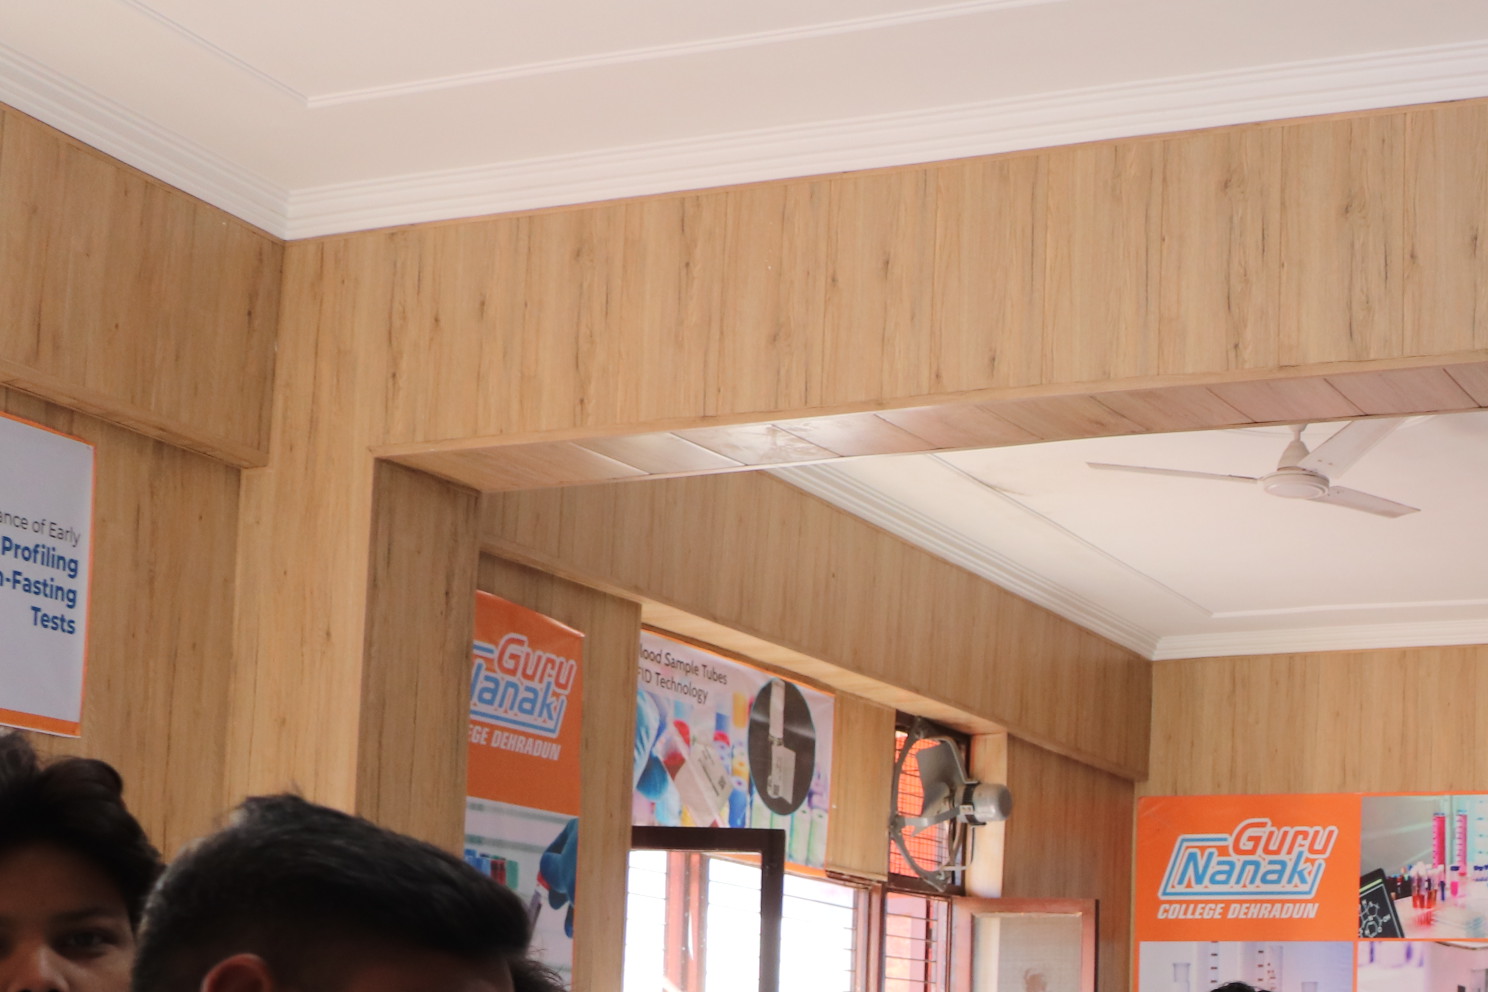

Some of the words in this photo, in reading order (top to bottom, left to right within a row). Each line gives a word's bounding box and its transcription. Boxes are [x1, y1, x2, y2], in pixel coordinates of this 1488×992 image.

[32, 519, 46, 533] of
[49, 522, 80, 548] Early
[2, 536, 78, 578] Profiling
[31, 606, 76, 634] Tests
[497, 636, 575, 693] Guru
[640, 643, 662, 664] lood
[664, 652, 699, 676] Sample
[702, 664, 727, 685] Tubes
[655, 672, 708, 704] Technology
[491, 730, 561, 760] DEHRADUN
[1232, 820, 1336, 856] Guru
[1177, 850, 1309, 885] Nanak
[1158, 903, 1224, 919] COLLEGE
[1227, 903, 1319, 919] DEHRADUN
